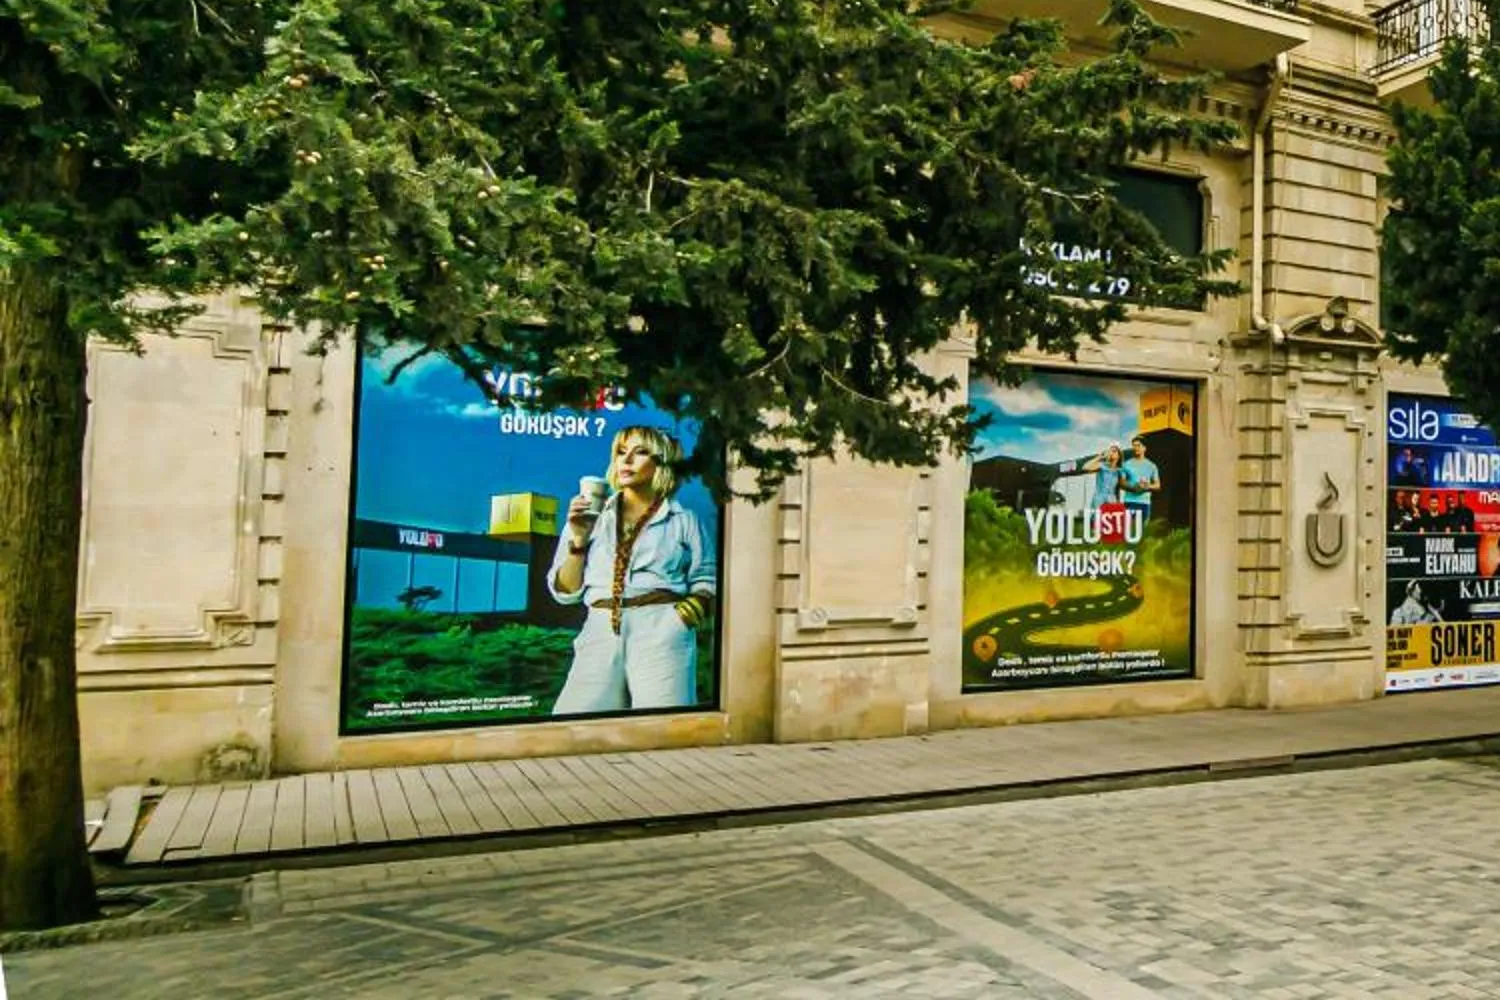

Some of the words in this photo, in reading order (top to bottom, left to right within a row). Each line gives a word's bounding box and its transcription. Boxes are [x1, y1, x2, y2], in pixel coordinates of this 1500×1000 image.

[1019, 237, 1101, 263] KLAM
[1425, 538, 1455, 552] MARK
[1431, 622, 1495, 666] SONER
